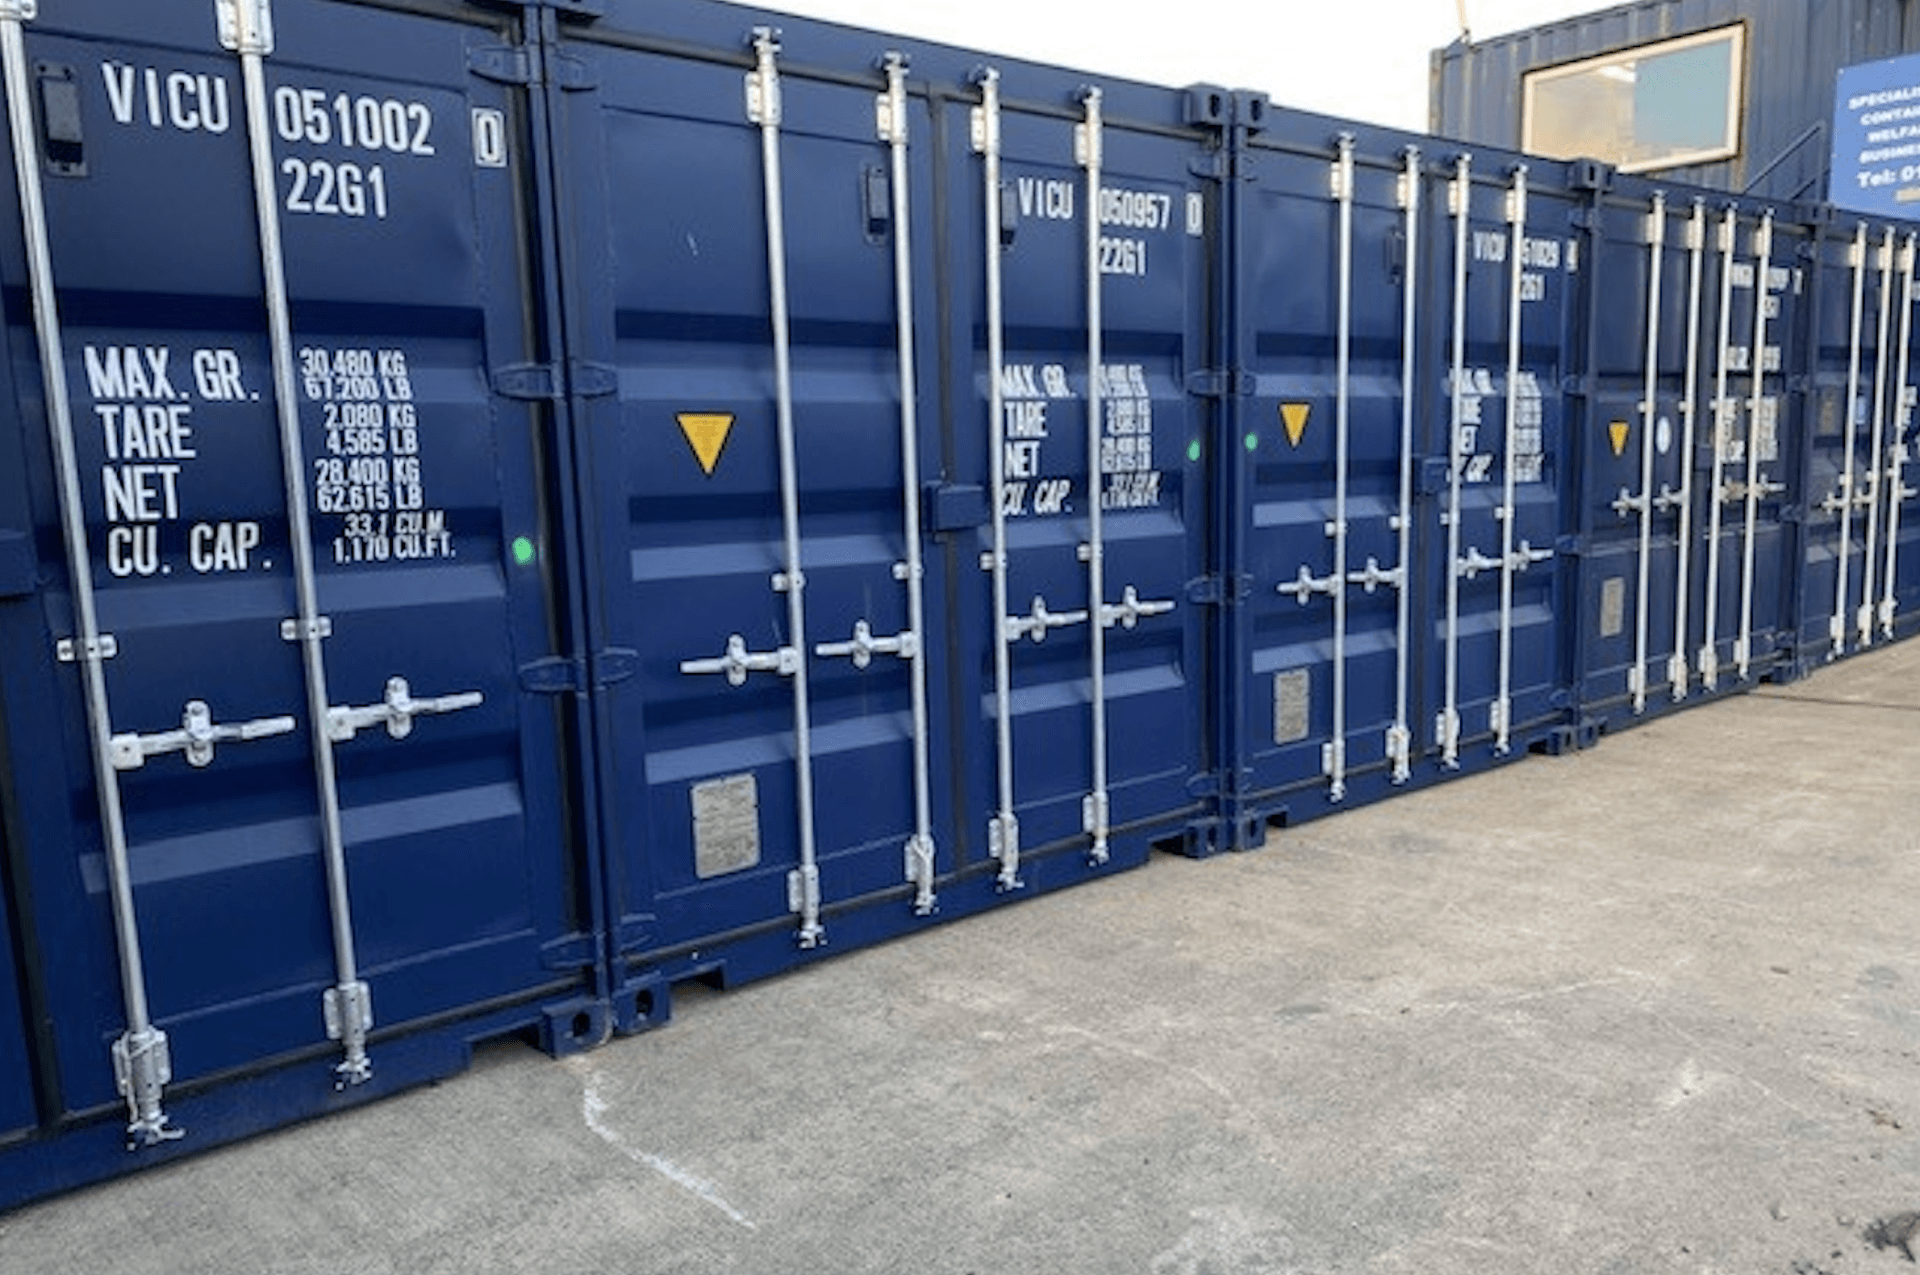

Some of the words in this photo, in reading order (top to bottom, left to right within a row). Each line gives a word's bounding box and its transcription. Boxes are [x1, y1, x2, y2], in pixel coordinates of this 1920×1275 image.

[102, 61, 229, 133] VICU
[275, 86, 435, 156] 051002
[476, 110, 503, 165] 0
[281, 158, 387, 218] 22G1
[1857, 168, 1897, 189] Tel:
[1018, 177, 1074, 219] VICU
[1099, 188, 1171, 231] 050957
[1099, 237, 1146, 276] 22G1
[84, 346, 190, 399] MAX.
[193, 349, 260, 400] GR.
[301, 348, 375, 377] 30.480
[378, 350, 407, 377] KG
[304, 376, 380, 400] 67.200
[383, 377, 413, 400] LB
[94, 403, 197, 460] TARE
[323, 402, 384, 431] 2.080
[387, 403, 417, 429] KG
[1004, 401, 1048, 437] TARE
[326, 429, 386, 456] 4.585
[390, 429, 419, 455] LB
[1004, 440, 1040, 477] NET
[314, 457, 389, 486] 28.400
[392, 456, 420, 485] KG
[102, 464, 181, 522] NET
[316, 485, 390, 512] 62.615
[395, 484, 423, 511] LB
[1034, 479, 1074, 514] CAP.
[108, 524, 172, 577] CU.
[190, 521, 273, 573] CAP.
[333, 534, 390, 563] 1.170
[393, 531, 456, 560] CU.FT.
